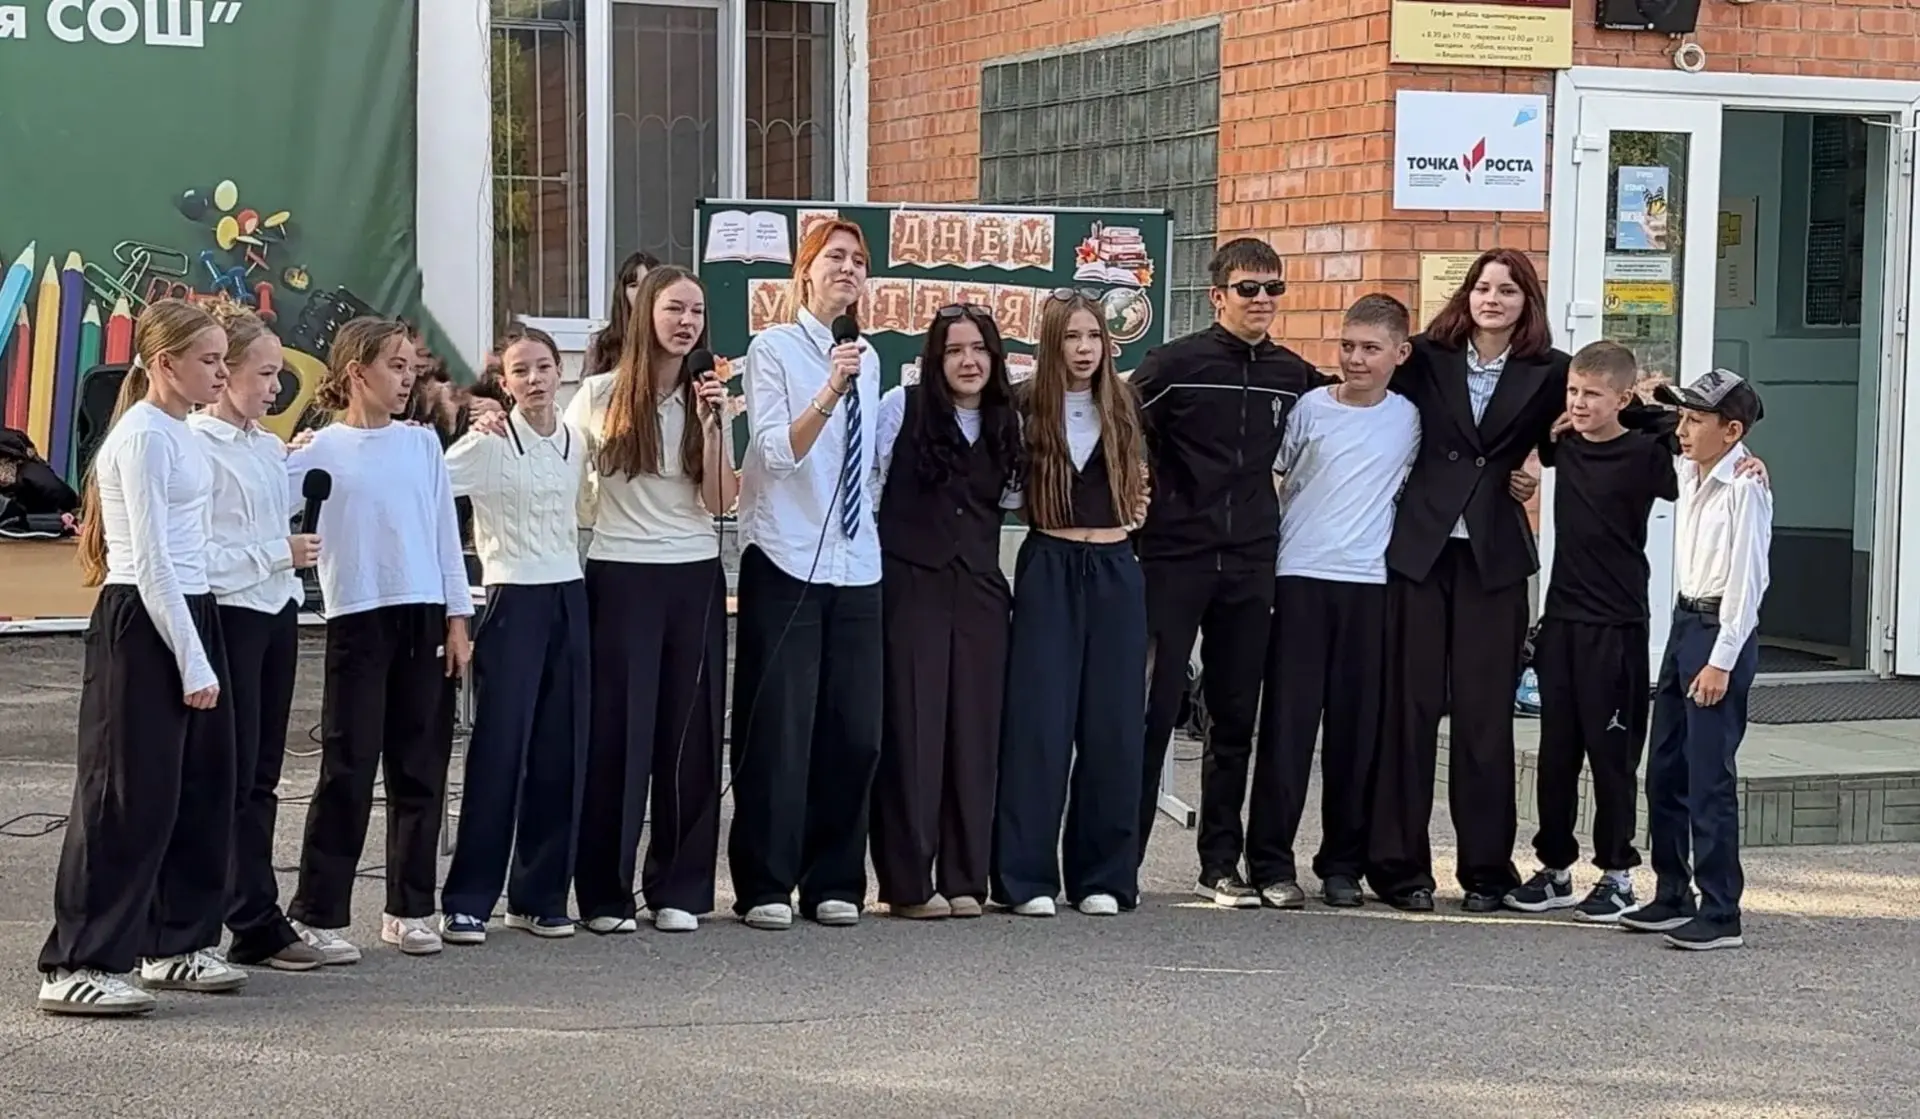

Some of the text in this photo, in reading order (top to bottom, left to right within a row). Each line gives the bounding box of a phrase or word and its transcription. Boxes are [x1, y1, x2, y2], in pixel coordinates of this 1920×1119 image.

[1407, 156, 1534, 173] ТОЧКА РОСТА
[900, 217, 1043, 254] ДНЁМ
